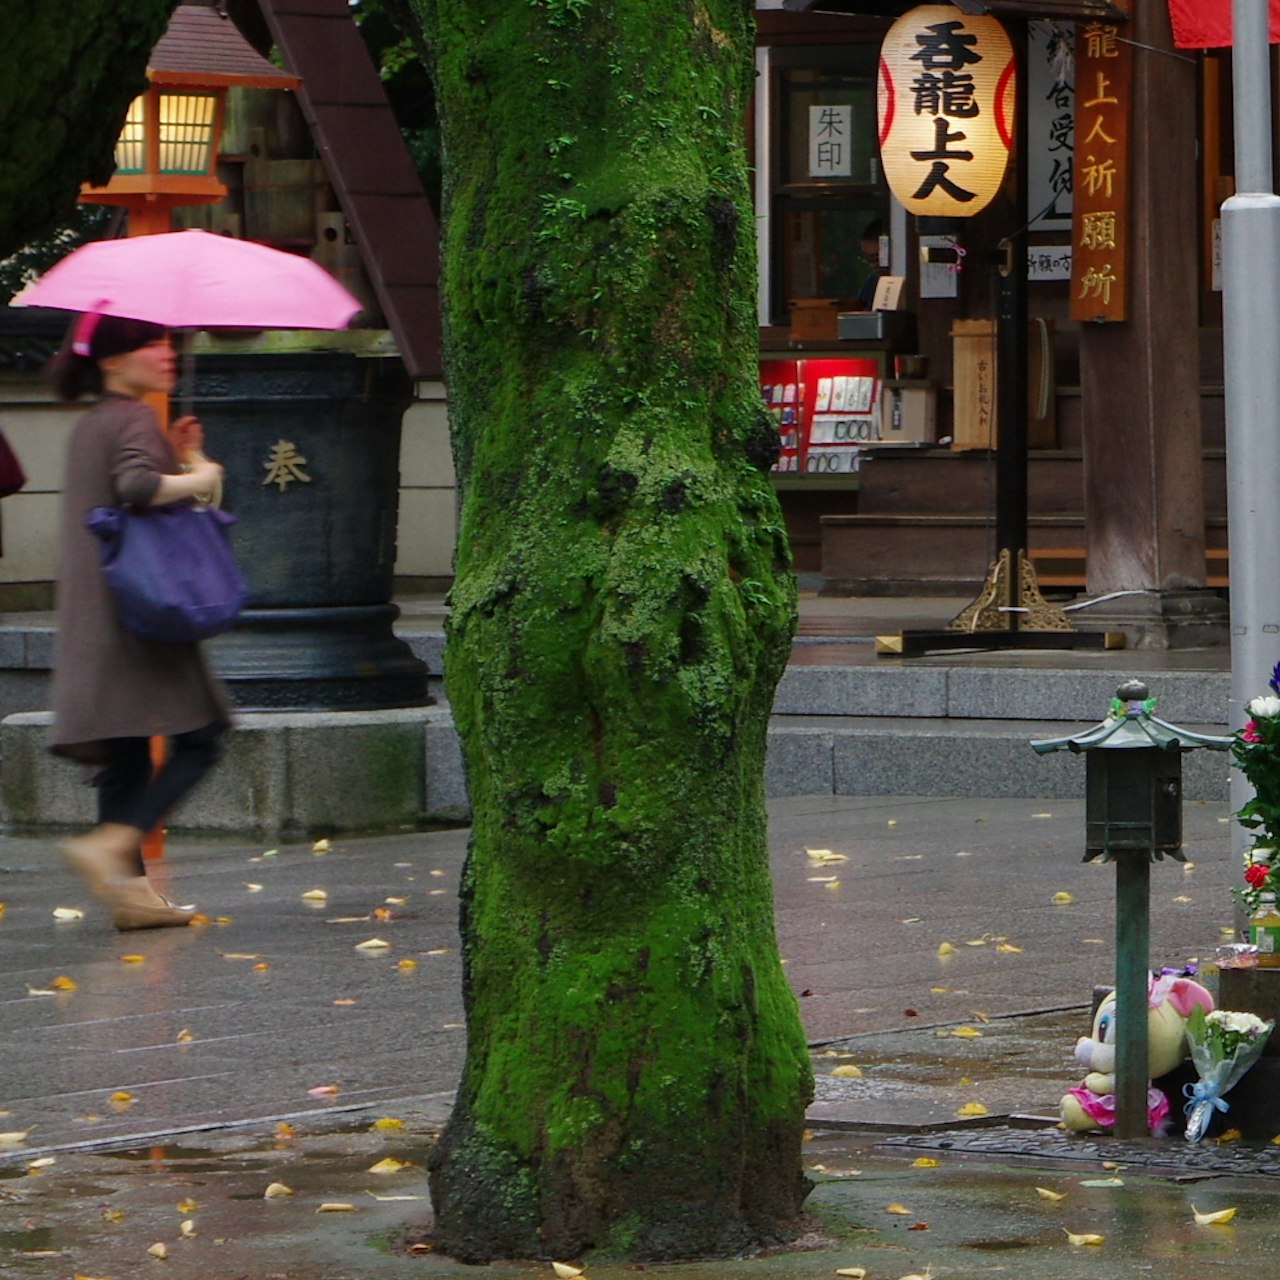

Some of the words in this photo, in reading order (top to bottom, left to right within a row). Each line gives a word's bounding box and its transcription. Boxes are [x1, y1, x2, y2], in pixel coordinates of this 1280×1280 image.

[817, 107, 843, 170] 朱印
[908, 21, 983, 202] 呑龍上人
[262, 439, 311, 493] 奉
